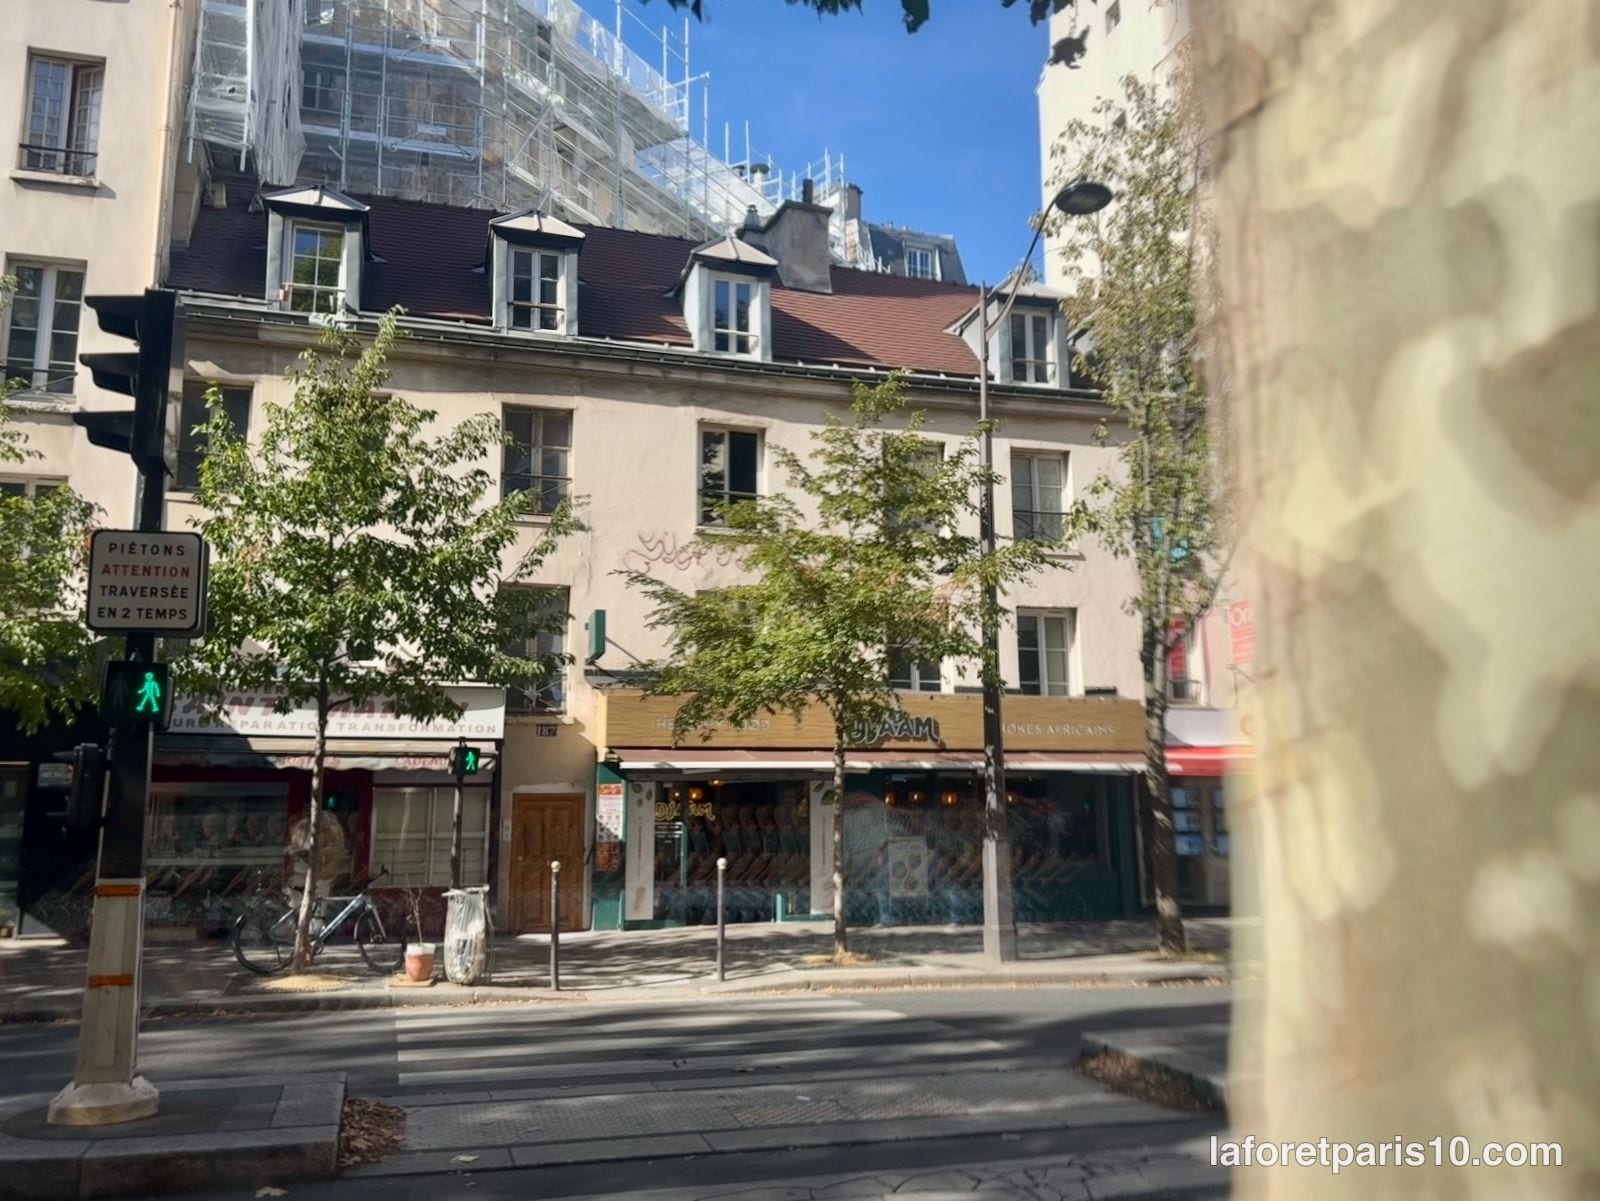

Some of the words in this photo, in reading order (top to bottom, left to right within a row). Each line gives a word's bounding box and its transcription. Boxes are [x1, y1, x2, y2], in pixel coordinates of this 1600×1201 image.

[108, 541, 185, 556] PIÉTONS
[102, 564, 190, 578] ATTENTION
[100, 584, 189, 599] TRAVERSÉE
[97, 607, 117, 618] EN
[121, 608, 131, 619] 2
[136, 607, 188, 620] TEMPS
[337, 721, 496, 734] TRANSFORMATION
